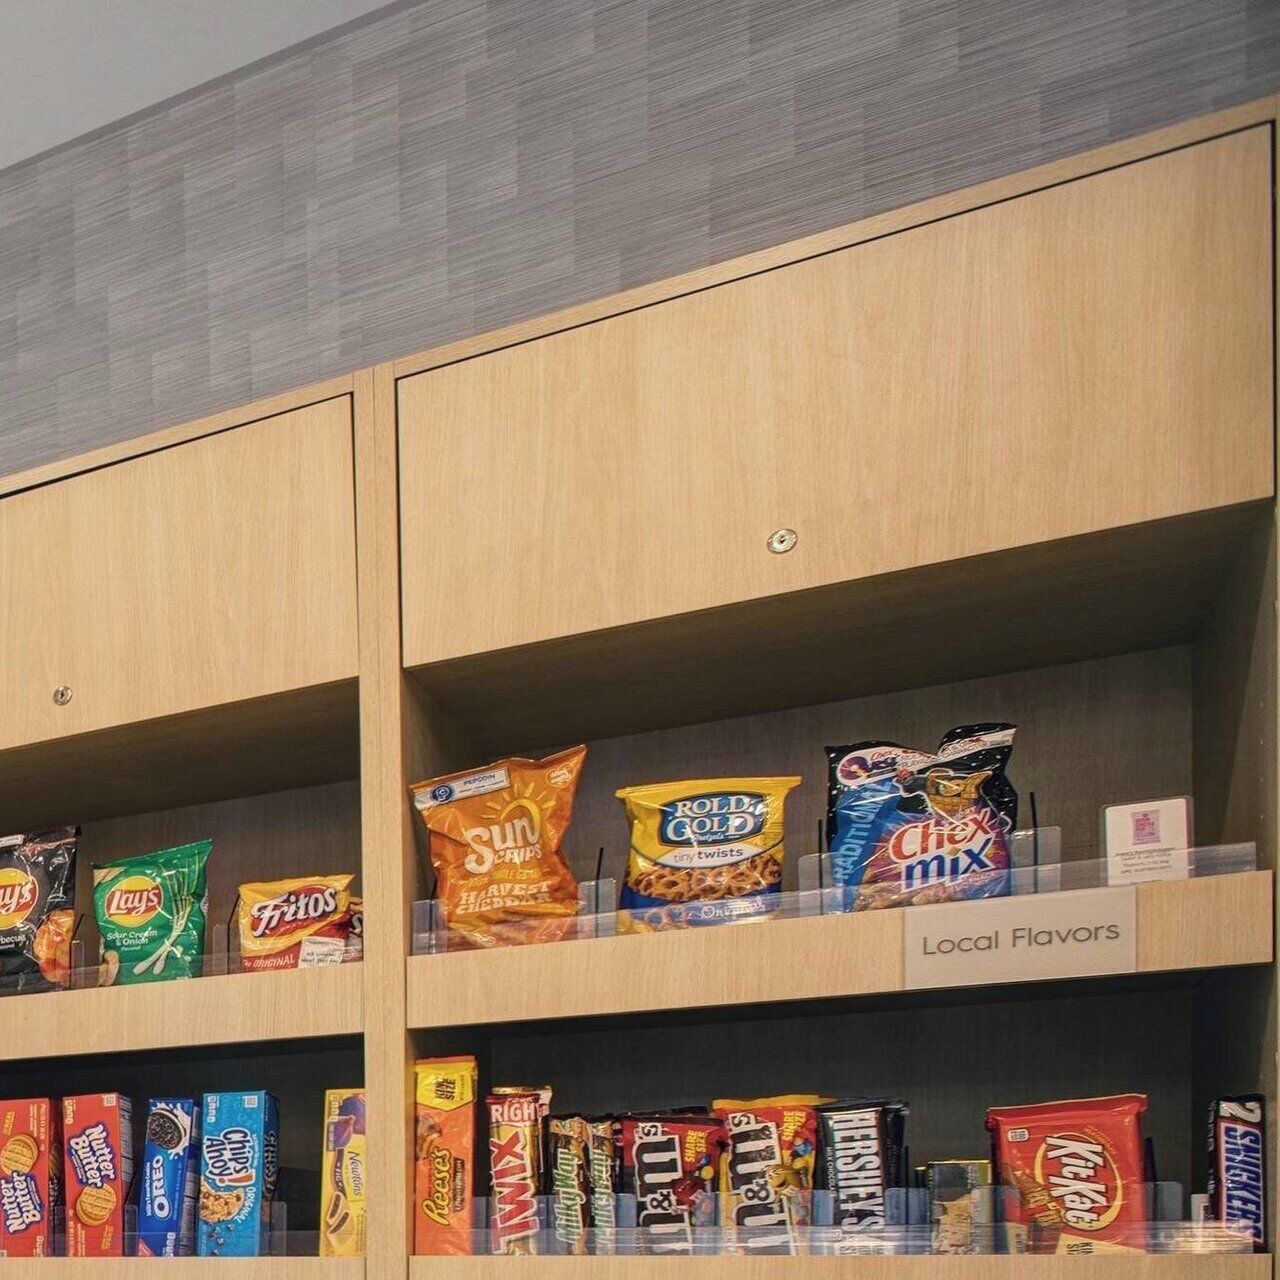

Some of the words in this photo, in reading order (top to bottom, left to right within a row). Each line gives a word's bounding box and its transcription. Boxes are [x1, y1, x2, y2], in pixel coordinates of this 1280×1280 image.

[675, 794, 745, 817] ROLD
[666, 813, 755, 842] GOLD
[891, 806, 991, 862] Chex
[464, 816, 541, 875] Sun
[494, 843, 542, 865] CHIPS
[673, 852, 696, 865] tiny
[697, 846, 744, 861] twists
[903, 837, 993, 890] mix
[109, 887, 161, 915] Lay's
[456, 893, 551, 915] CHEDDAR
[461, 880, 552, 904] HARVEST
[251, 887, 338, 937] Fritos
[107, 931, 128, 941] Sour
[129, 929, 158, 939] Cream
[923, 929, 999, 955] Local
[1012, 922, 1120, 949] Flavors
[252, 954, 296, 968] ORIGINAL
[782, 1110, 795, 1142] SHARE
[794, 1110, 807, 1134] SIZE
[1218, 1100, 1262, 1123] 2
[84, 1124, 116, 1181] Nutter
[222, 1128, 251, 1175] Chips
[684, 1129, 697, 1162] SHARE
[697, 1131, 708, 1153] SIZE
[69, 1136, 105, 1188] Butter
[347, 1151, 362, 1197] Newtons
[831, 1109, 886, 1233] HERSHEY'S
[12, 1172, 42, 1226] Butter
[153, 1155, 171, 1220] OREO
[491, 1131, 539, 1254] TWIX
[1242, 1127, 1263, 1242] SNICKERS
[2, 1179, 26, 1235] Nutter
